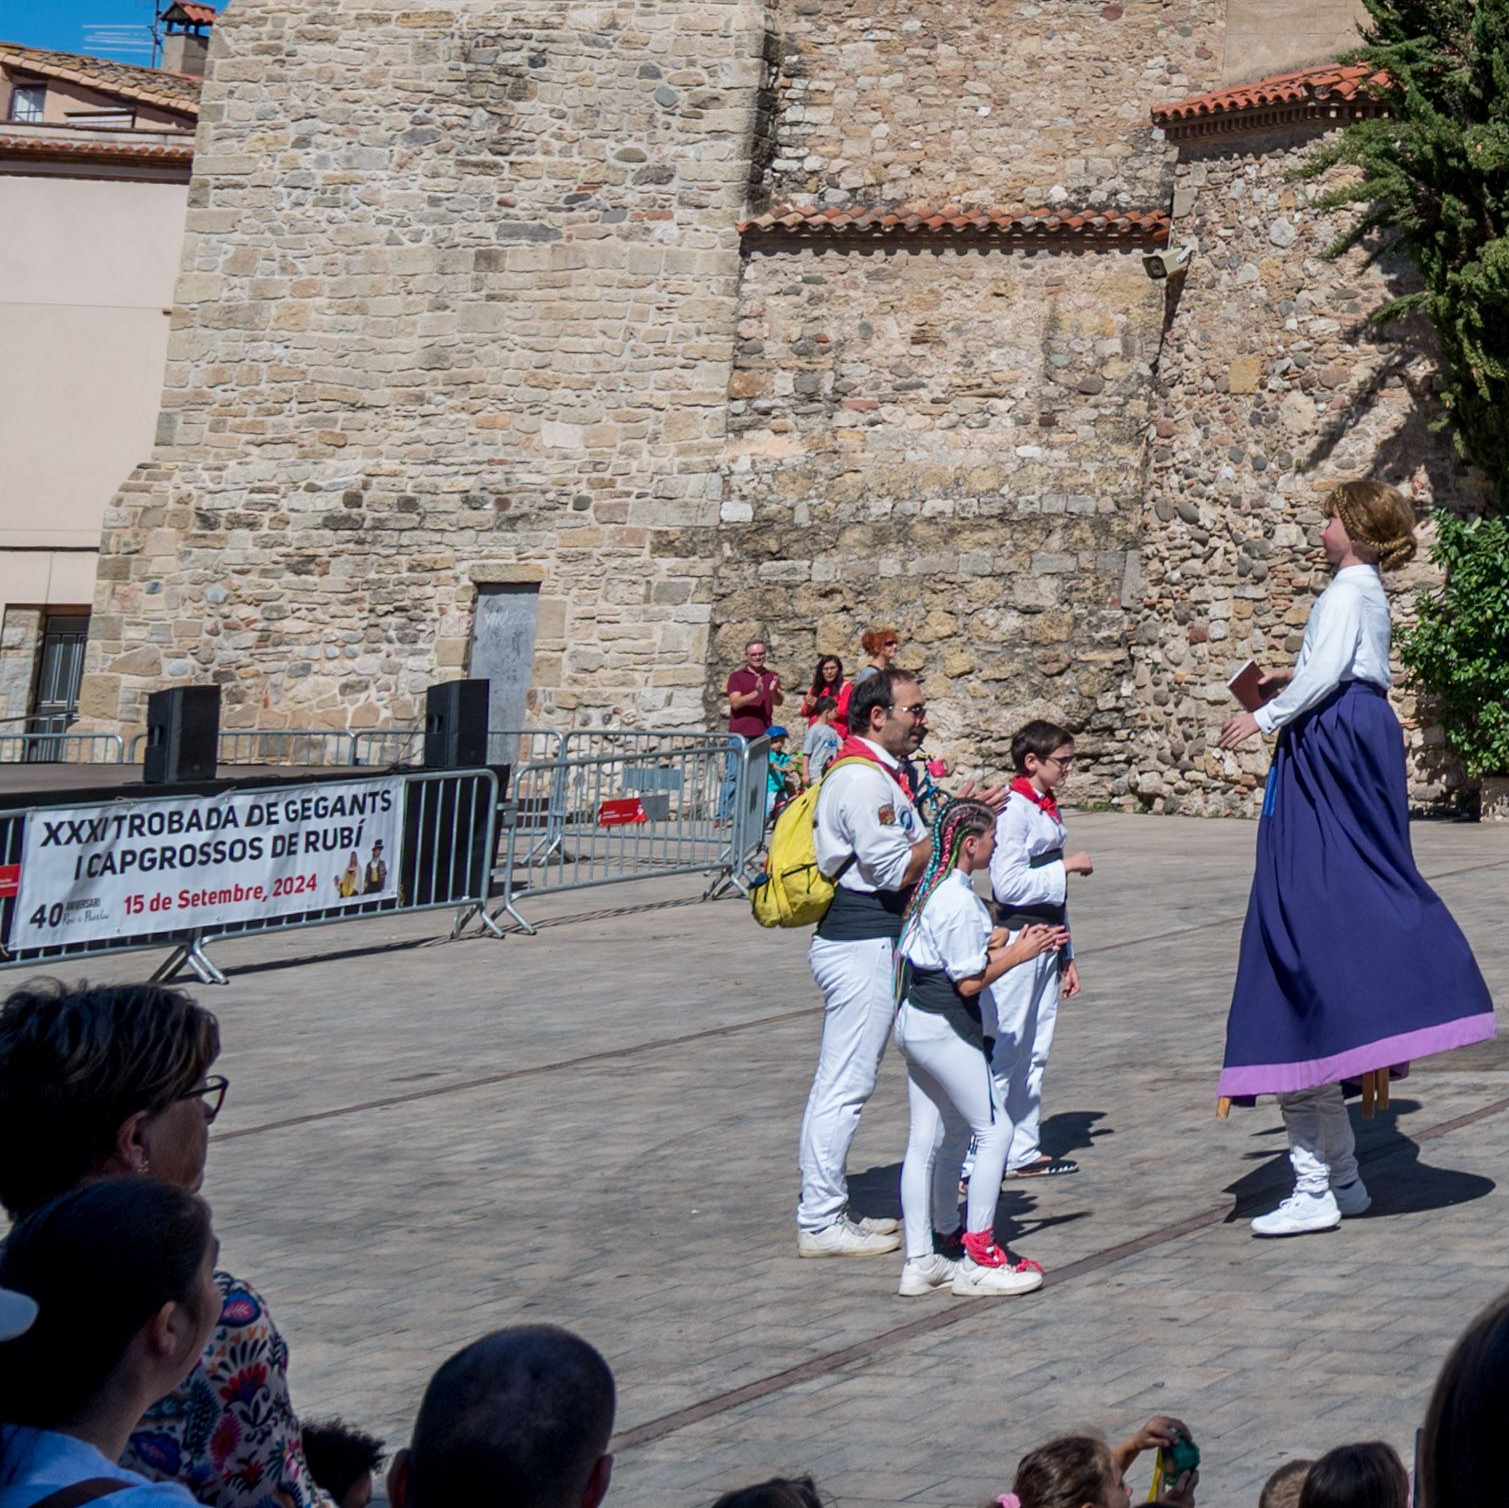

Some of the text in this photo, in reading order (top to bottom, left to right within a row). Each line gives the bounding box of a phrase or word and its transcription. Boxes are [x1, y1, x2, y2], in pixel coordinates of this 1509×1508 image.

[40, 789, 392, 847] XXXI TROBADA DE GEGANTS
[74, 819, 366, 881] I CAPGROSSOS DE RUBÍ
[29, 902, 63, 929] 40
[124, 873, 317, 915] 15 de Setembre, 2024
